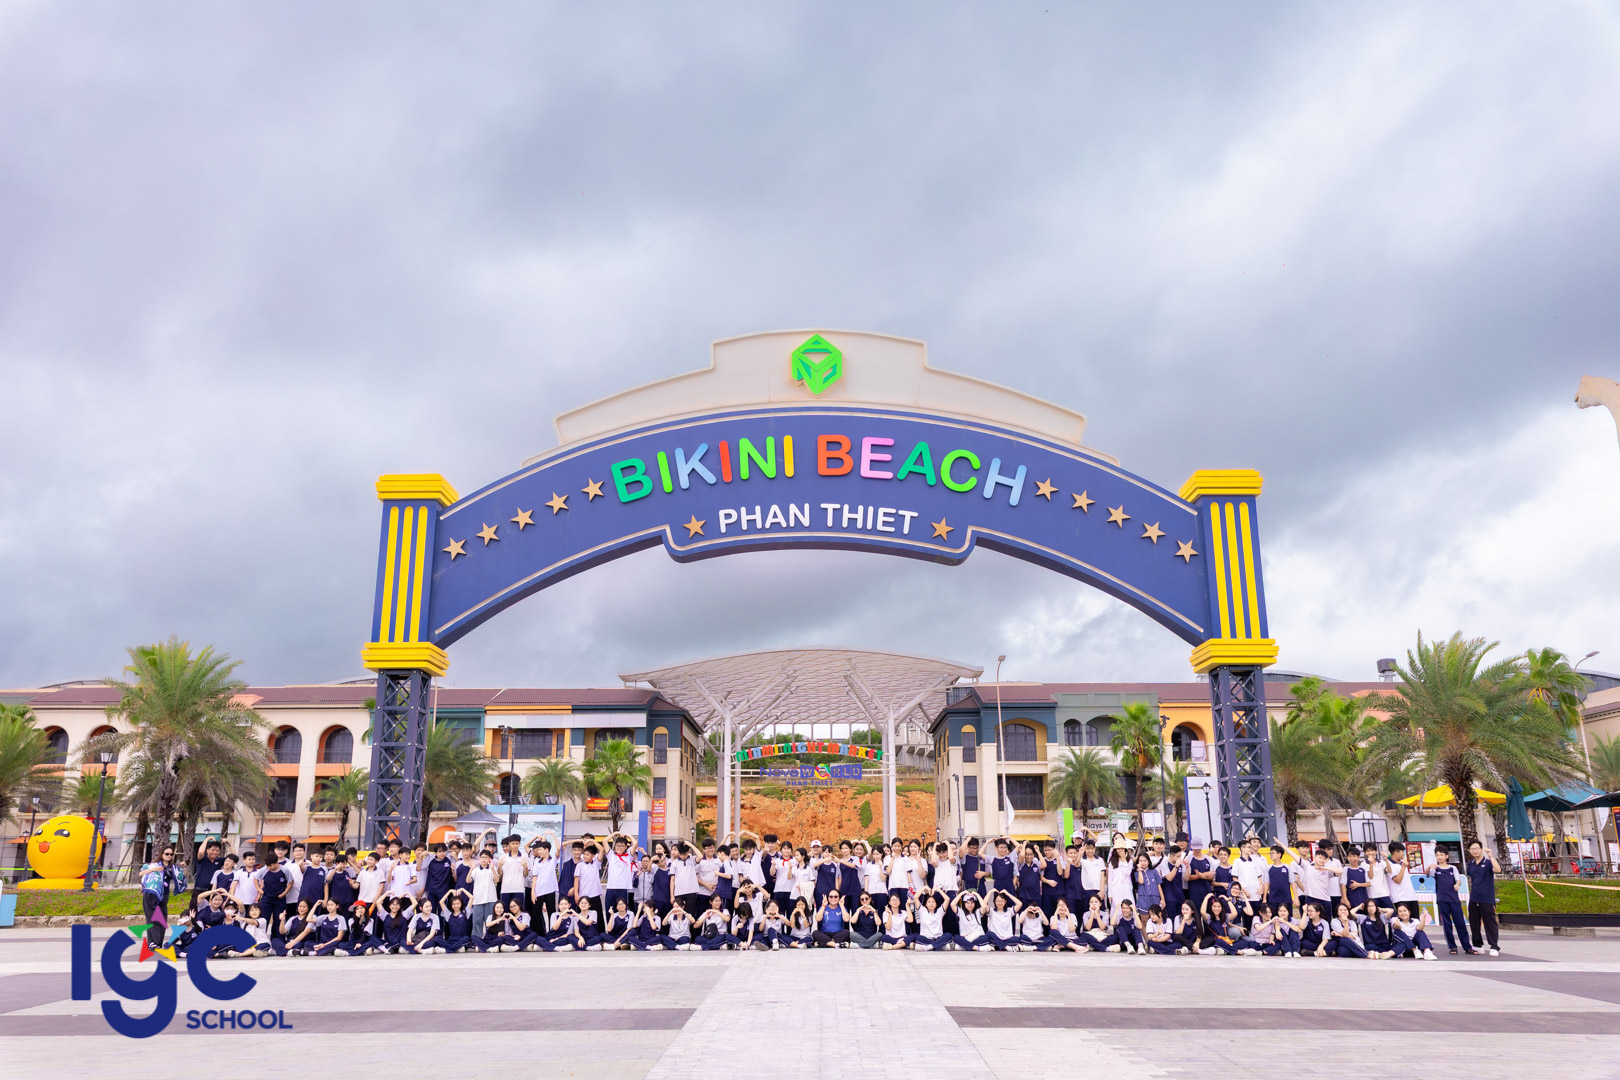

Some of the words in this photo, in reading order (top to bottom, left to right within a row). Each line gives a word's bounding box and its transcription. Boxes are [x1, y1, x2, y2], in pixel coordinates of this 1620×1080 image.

[611, 435, 794, 503] BIKINI
[817, 434, 1027, 506] BEACH
[719, 503, 810, 533] PHAN
[820, 503, 919, 534] THIET
[736, 744, 779, 762] MIAMI
[783, 742, 824, 754] NIGHT
[827, 742, 884, 761] MARKET
